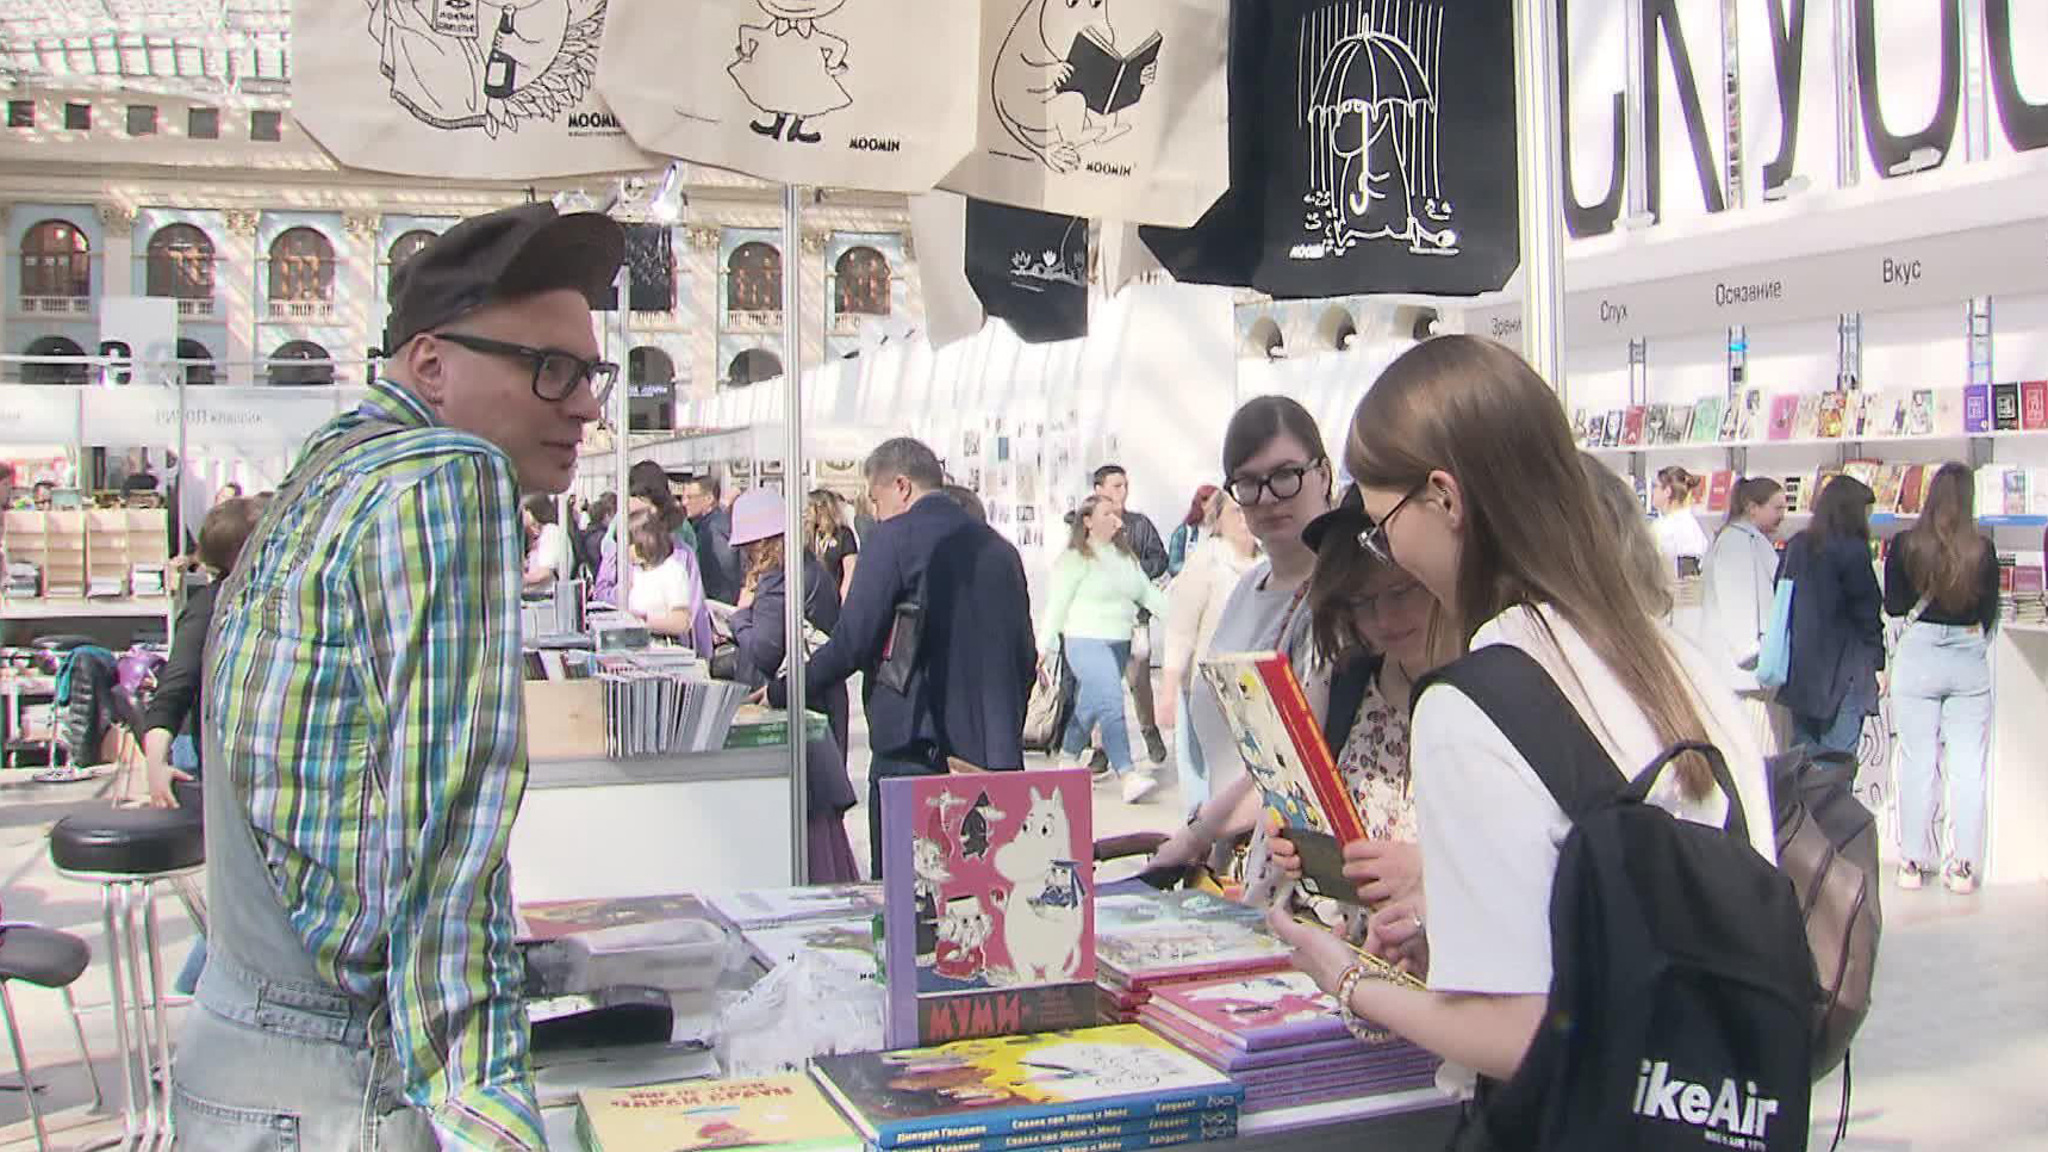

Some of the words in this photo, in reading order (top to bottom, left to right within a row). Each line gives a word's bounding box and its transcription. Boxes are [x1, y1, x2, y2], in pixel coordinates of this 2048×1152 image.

[848, 136, 900, 152] MOOMIN
[1086, 160, 1132, 176] MOOMIN
[1882, 257, 1921, 285] Вкус
[1715, 280, 1782, 306] Осязание
[1600, 301, 1628, 321] Слух
[1633, 1058, 1779, 1137] ikeAir
